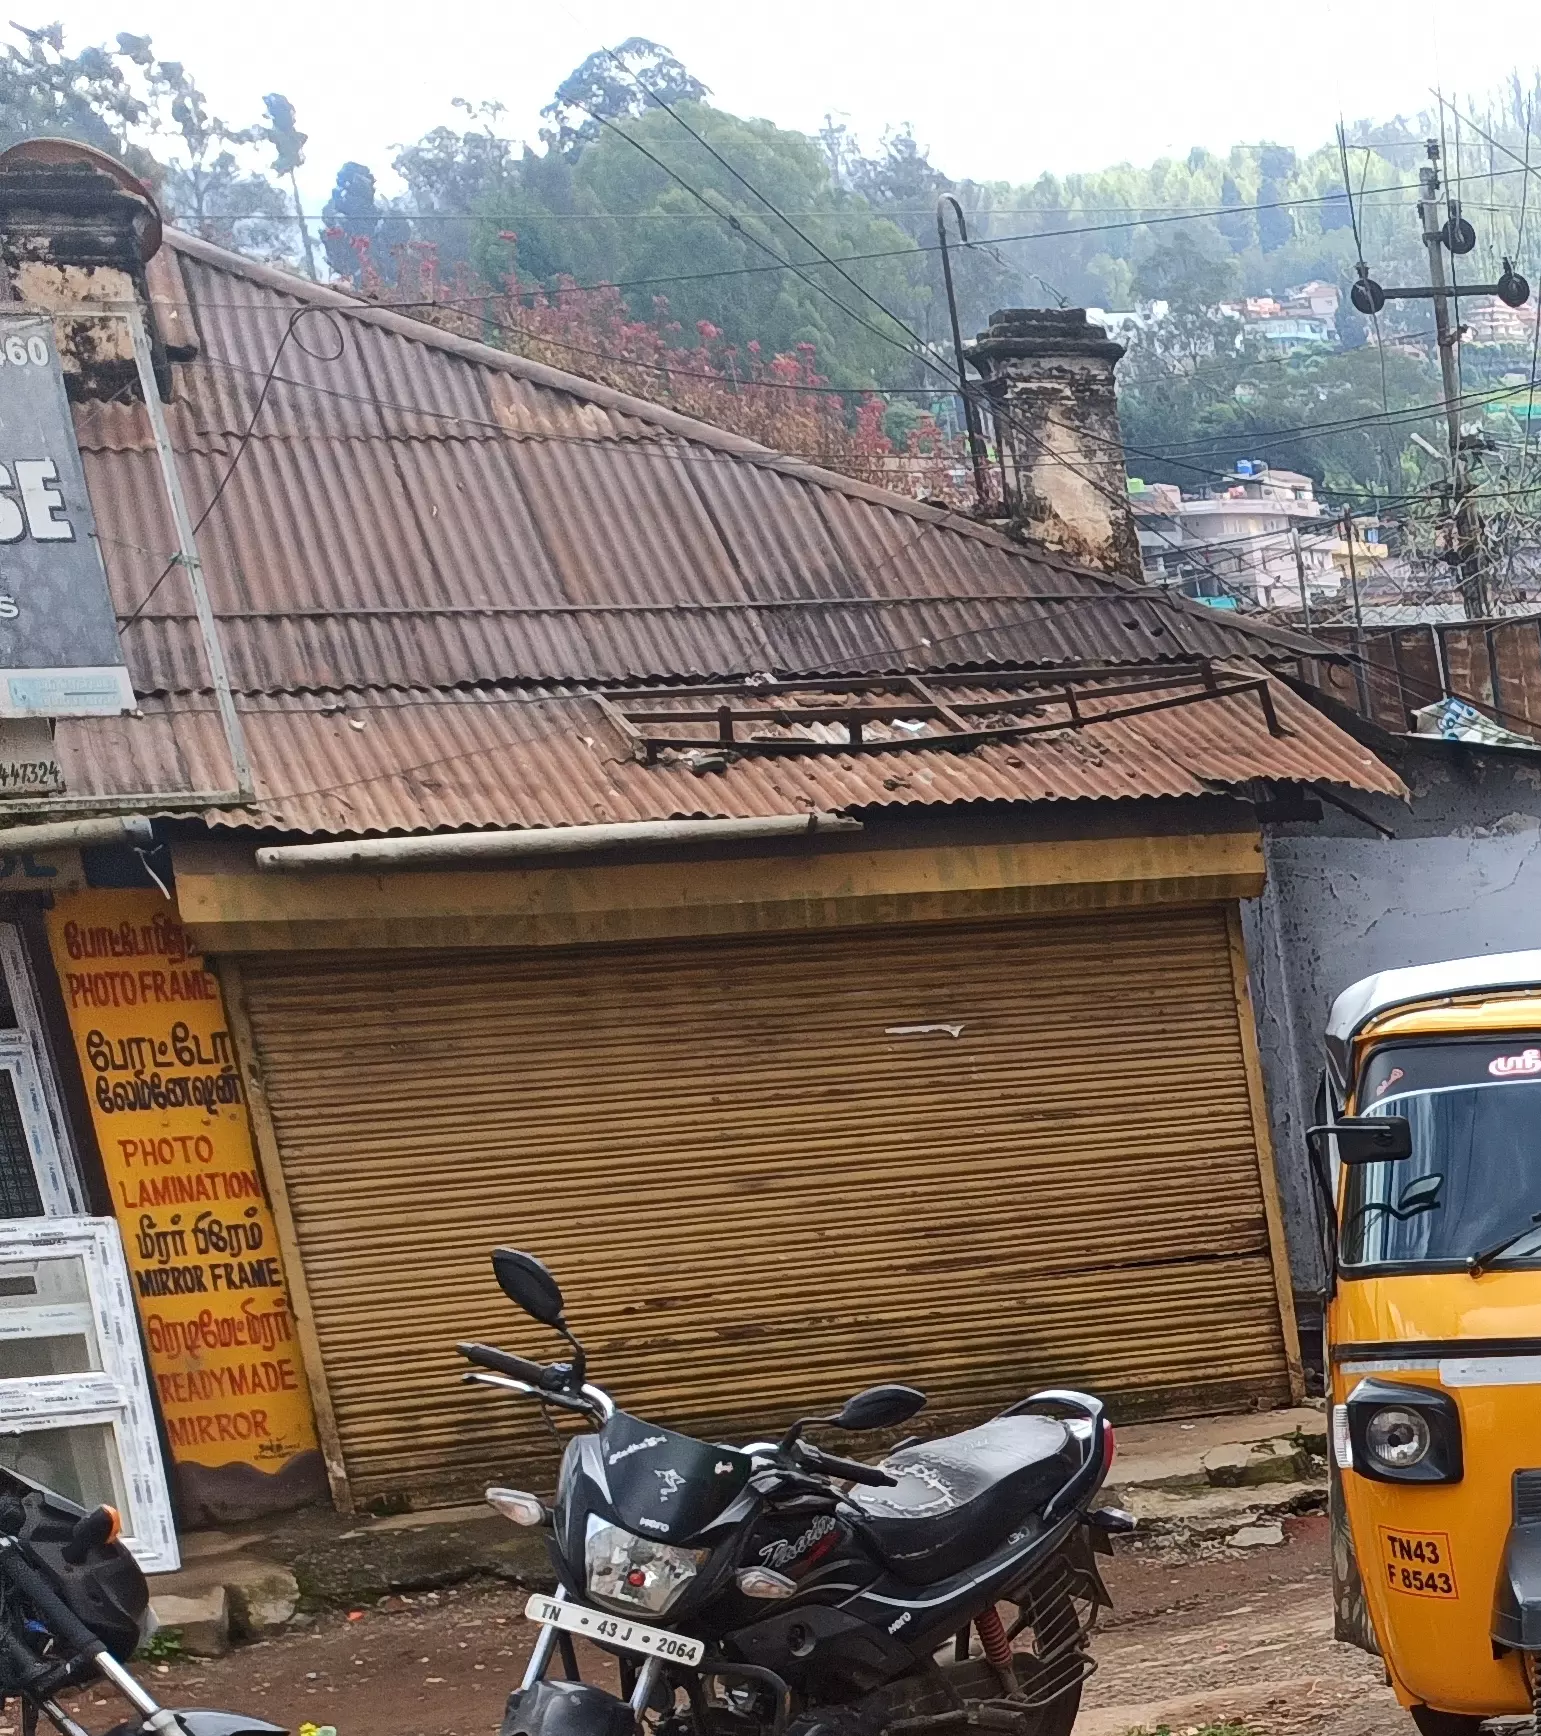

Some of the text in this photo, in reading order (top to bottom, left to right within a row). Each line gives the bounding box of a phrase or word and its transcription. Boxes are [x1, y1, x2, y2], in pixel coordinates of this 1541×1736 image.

[0, 336, 49, 367] 60
[86, 1021, 236, 1073] போட்டோ
[118, 1134, 214, 1168] PHOTO
[118, 1169, 262, 1208] LAMINATION
[135, 1257, 283, 1298] MIRROR FRAME
[158, 1359, 298, 1404] READYMADE
[166, 1409, 271, 1446] MIRROR
[1387, 1535, 1439, 1564] TN43
[1388, 1563, 1452, 1593] F 8543
[540, 1602, 562, 1622] TN
[656, 1637, 697, 1661] 2064
